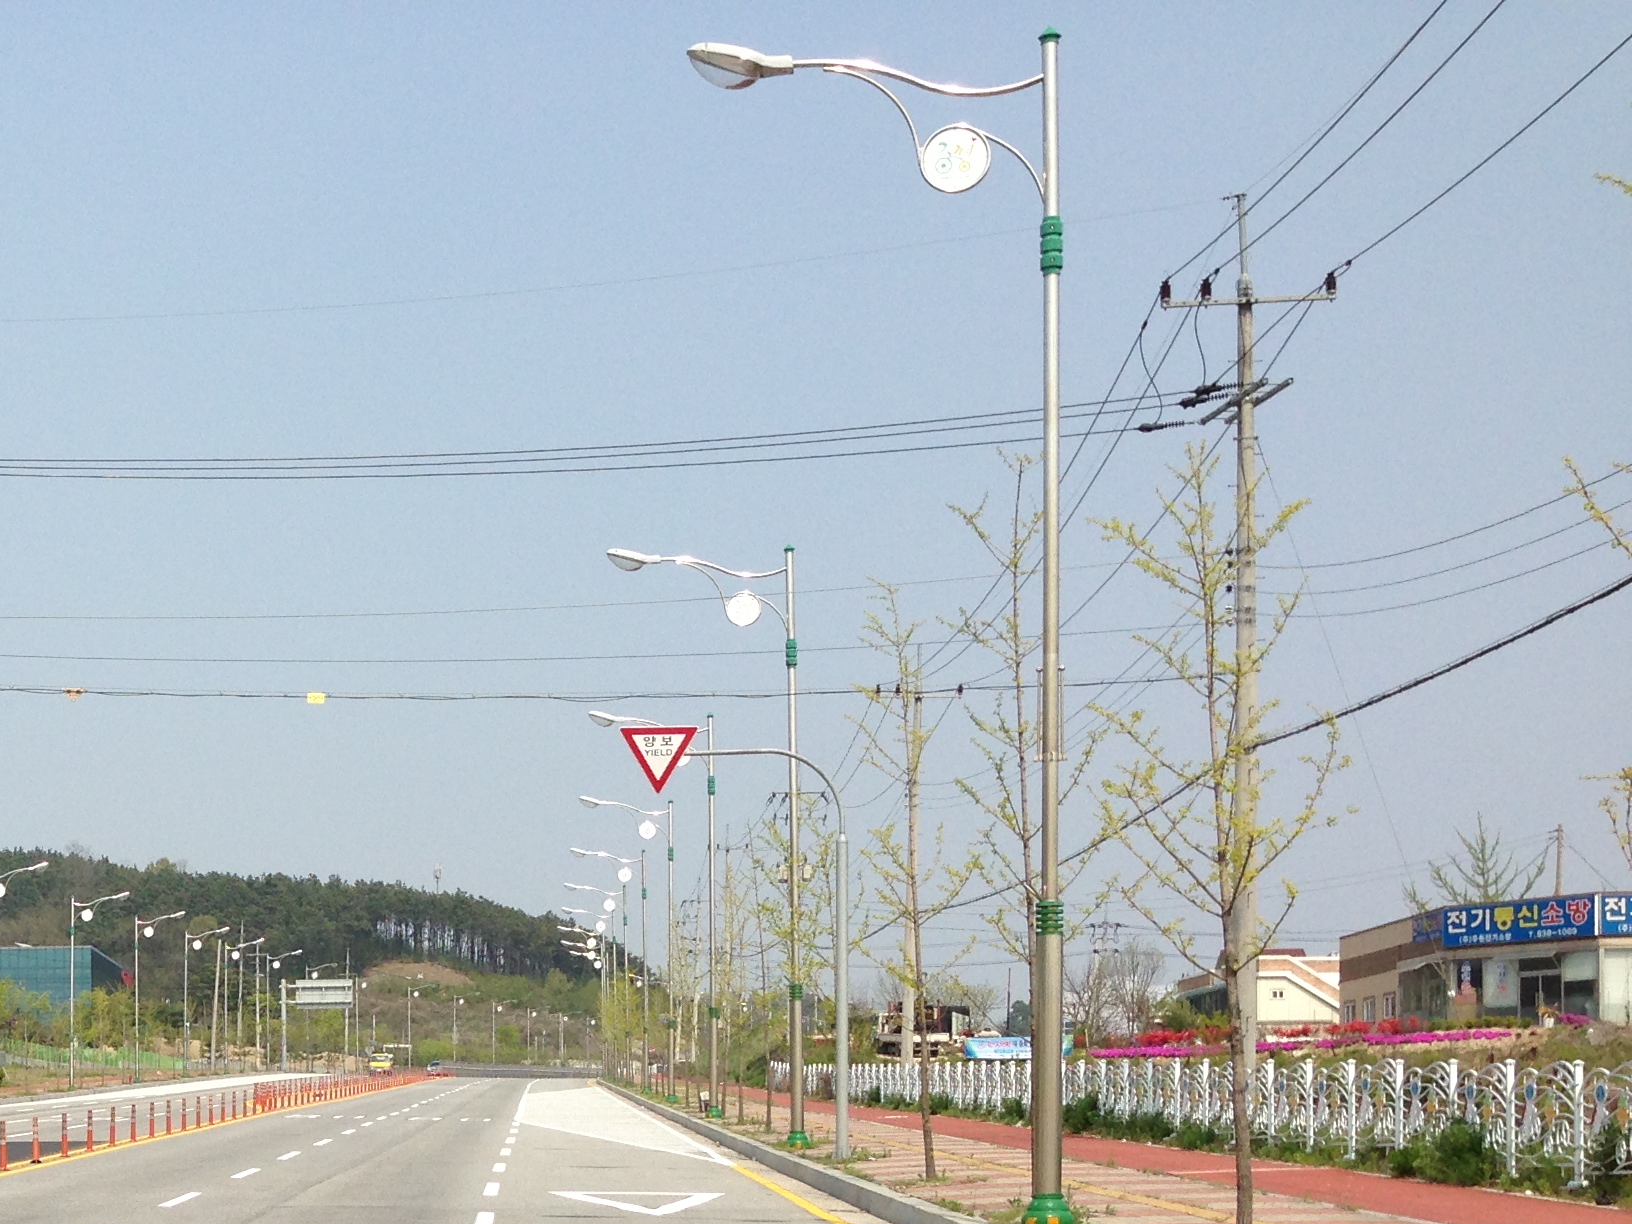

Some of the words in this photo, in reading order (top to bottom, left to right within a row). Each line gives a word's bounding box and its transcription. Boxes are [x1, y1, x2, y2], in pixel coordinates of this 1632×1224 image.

[643, 736, 673, 747] 양보
[644, 749, 673, 757] YIELD
[1446, 899, 1591, 934] 전기통신소방
